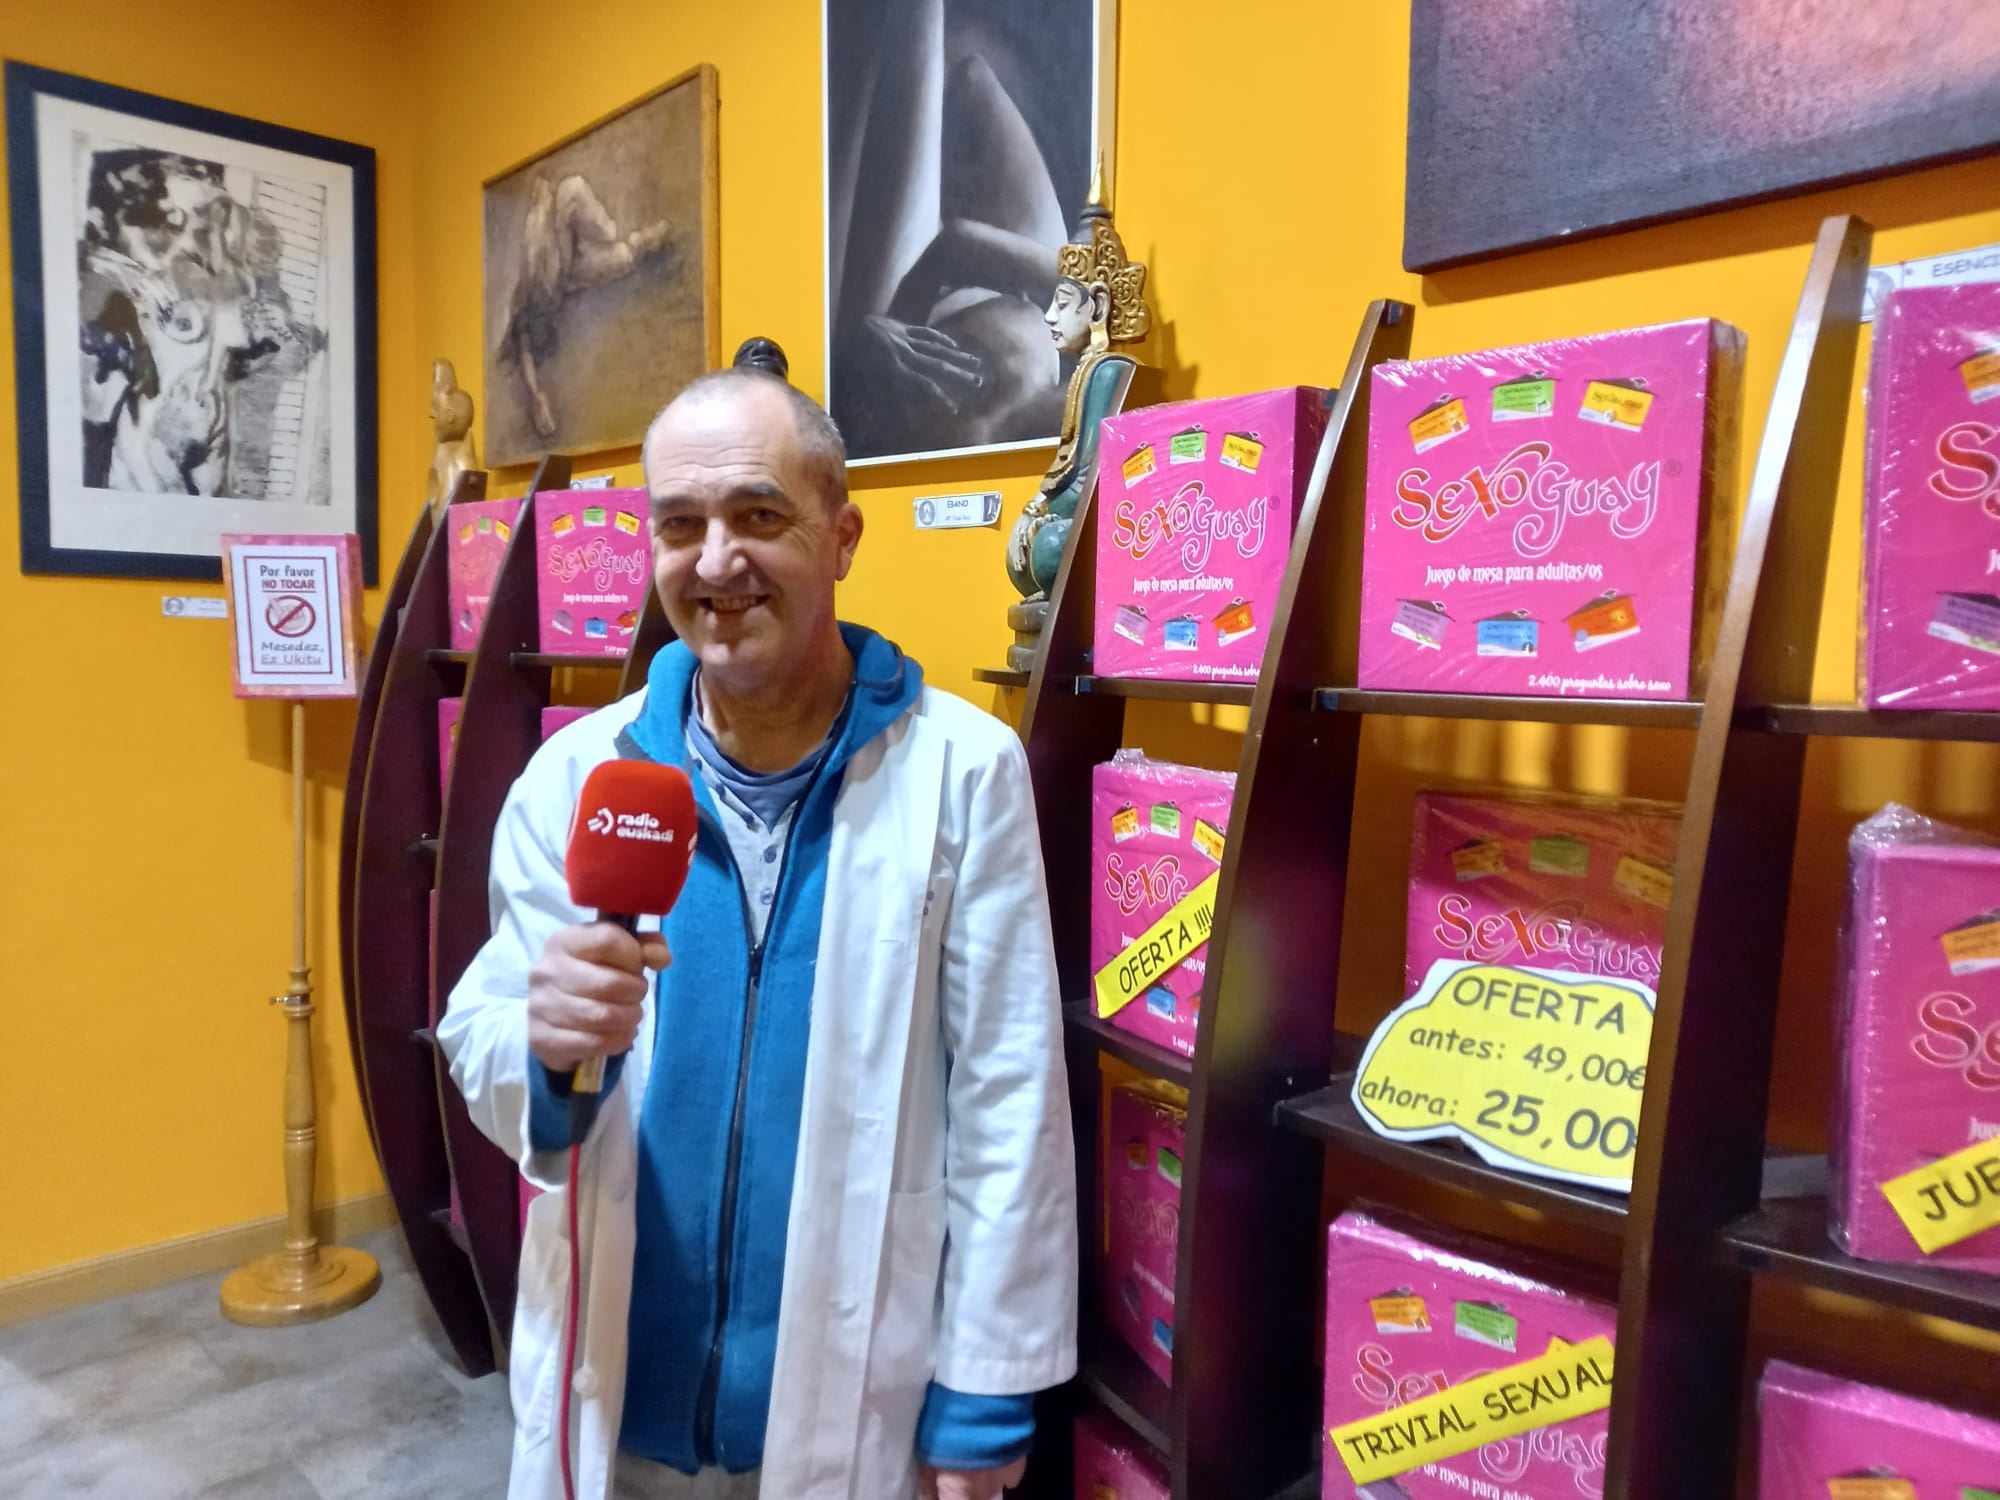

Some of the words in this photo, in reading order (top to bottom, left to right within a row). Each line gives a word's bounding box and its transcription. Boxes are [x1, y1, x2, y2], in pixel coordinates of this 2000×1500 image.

[260, 564, 279, 577] Por
[284, 564, 315, 577] favor
[262, 579, 277, 589] NO
[280, 579, 316, 589] TOCAR
[1425, 565, 1456, 590] Juego
[1457, 564, 1472, 582] de
[1473, 566, 1504, 584] mesa
[1505, 565, 1534, 585] para
[1536, 561, 1603, 583] adultas/os
[283, 654, 321, 666] Ukitu
[616, 826, 674, 843] euskadi
[617, 812, 659, 828] radio
[1118, 919, 1193, 994] OFERTA
[1453, 975, 1626, 1034] OFERTA
[1409, 1026, 1506, 1059] antes:
[1522, 1043, 1645, 1092] 49,00€
[1360, 1075, 1458, 1117] ahora:
[1476, 1089, 1637, 1159] 25,00
[1343, 1403, 1477, 1464] TRIVIAL
[1483, 1356, 1614, 1422] SEXUAL
